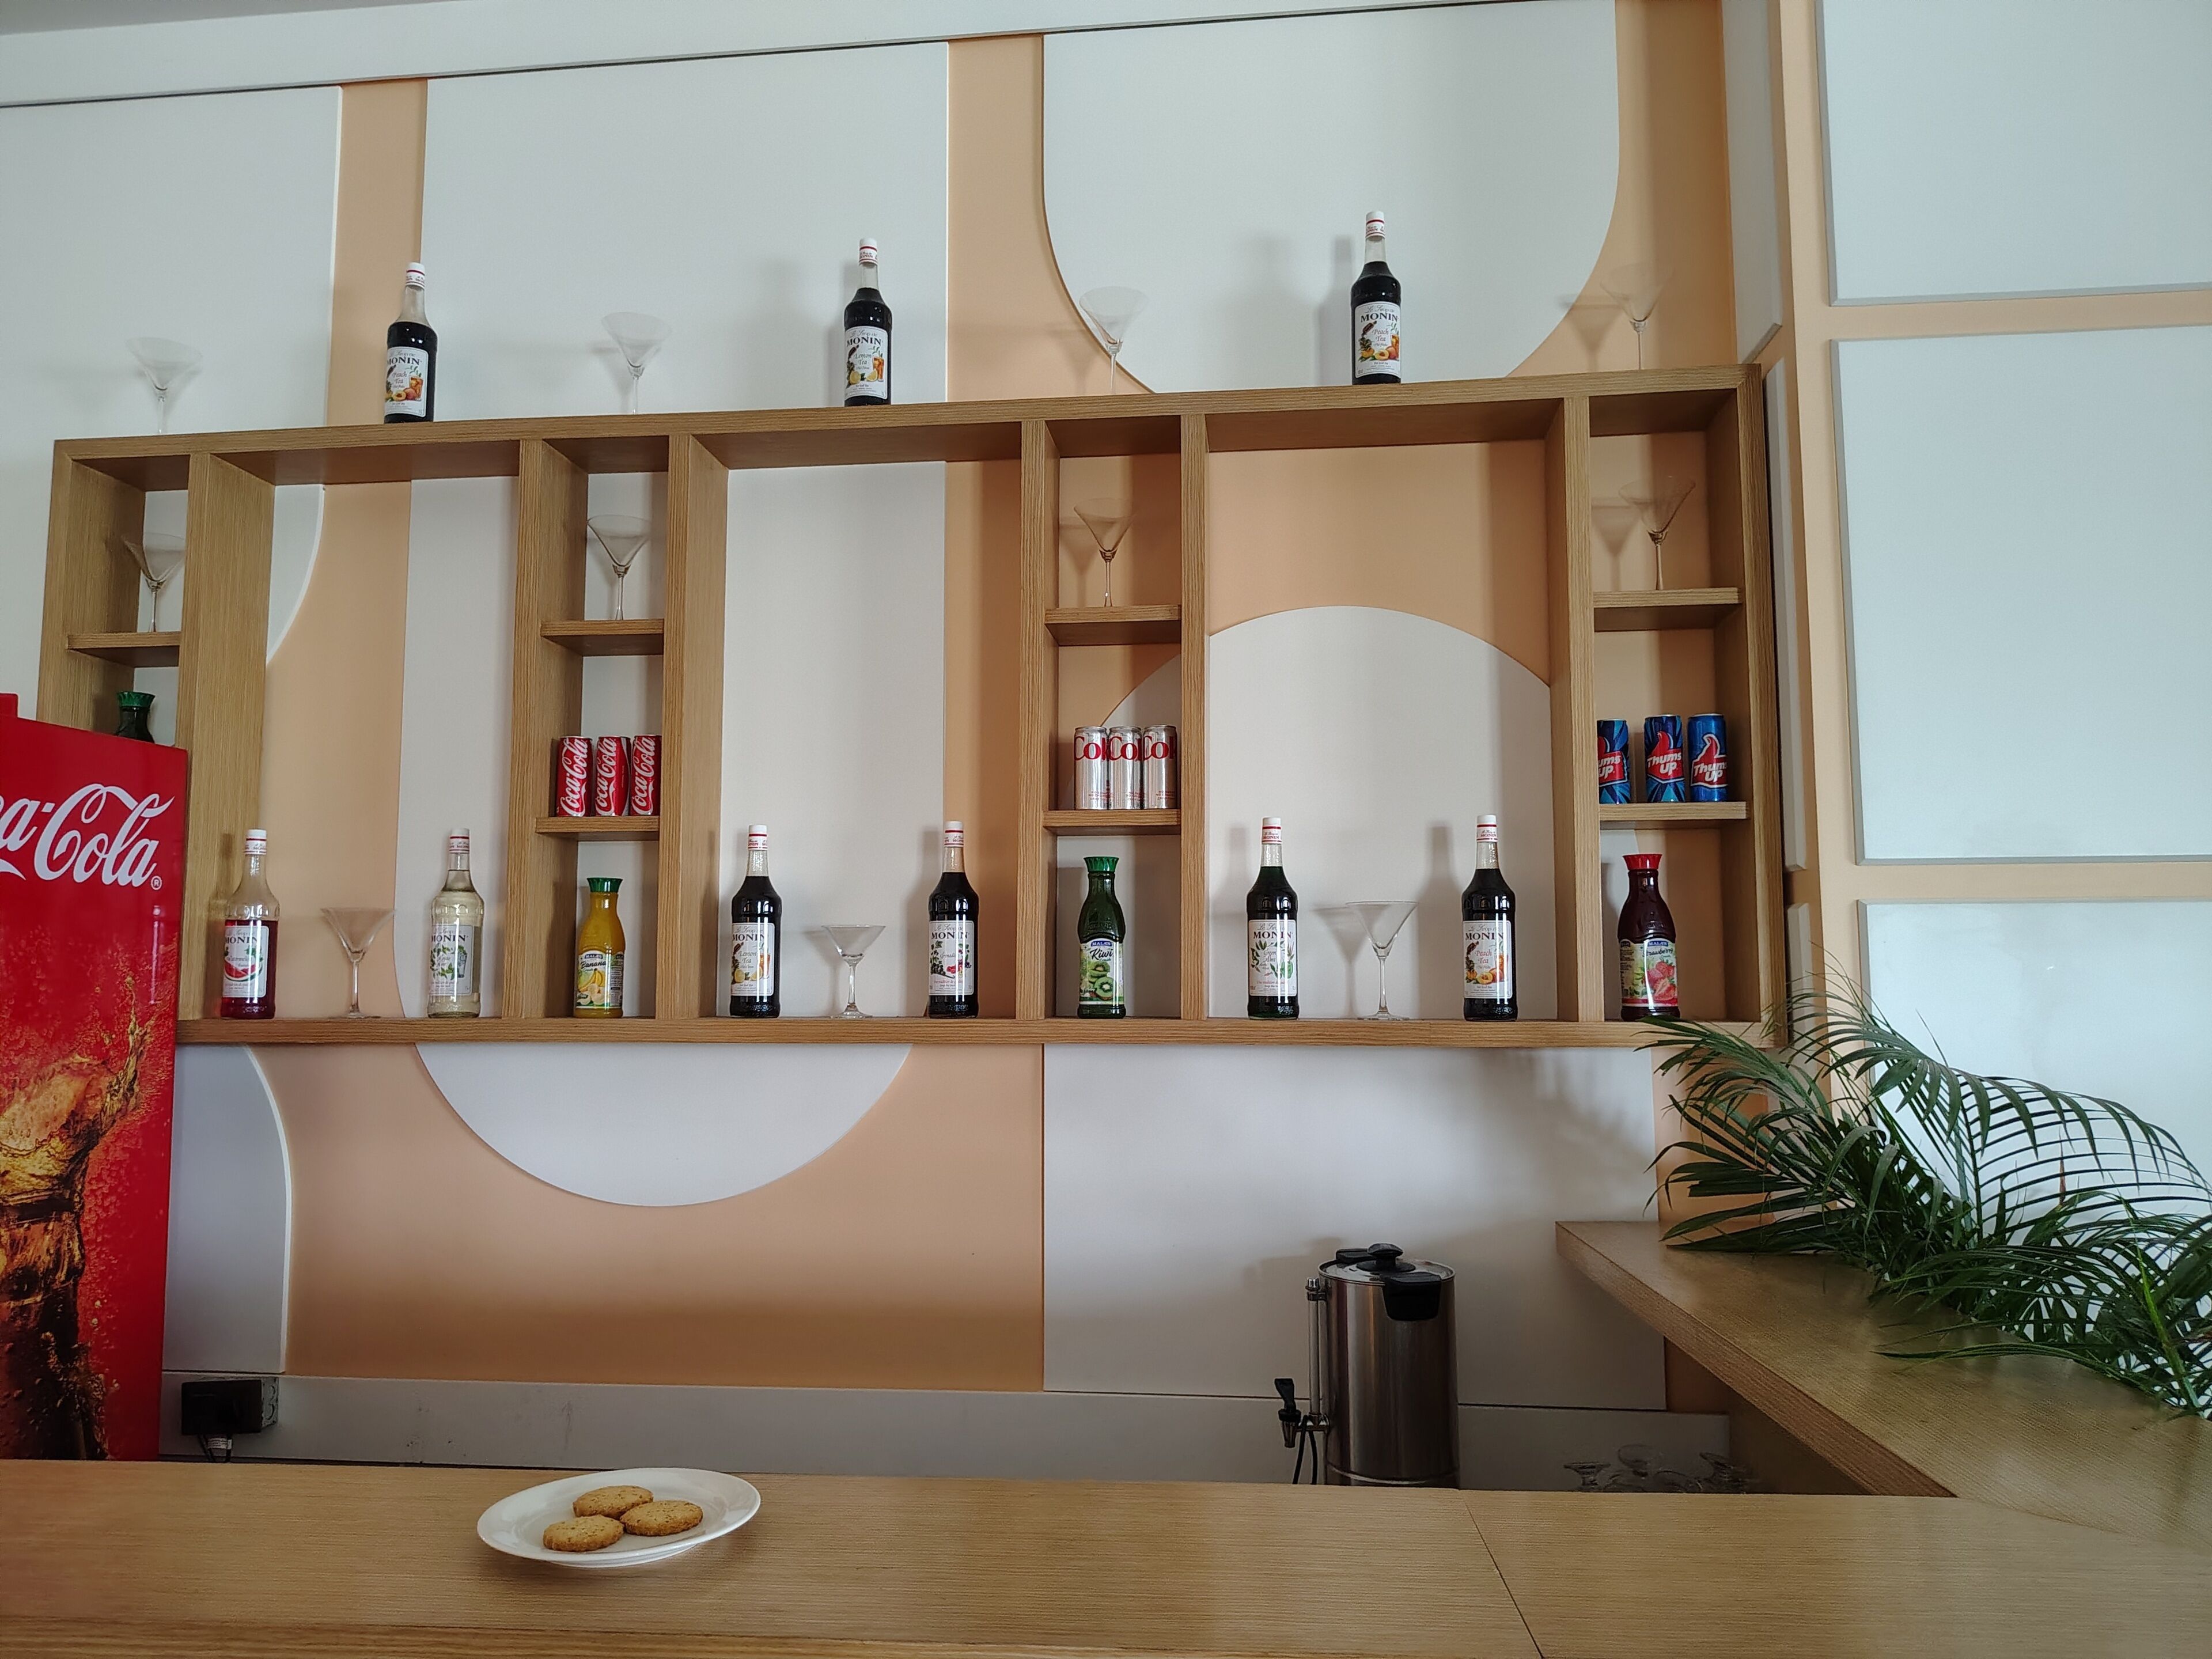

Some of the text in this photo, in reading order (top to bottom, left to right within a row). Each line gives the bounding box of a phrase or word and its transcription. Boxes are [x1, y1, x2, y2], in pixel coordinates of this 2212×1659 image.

[1361, 313, 1399, 323] MONIN
[847, 336, 881, 346] MONIN
[1090, 948, 1113, 960] Kiwi
[581, 961, 606, 969] Banana
